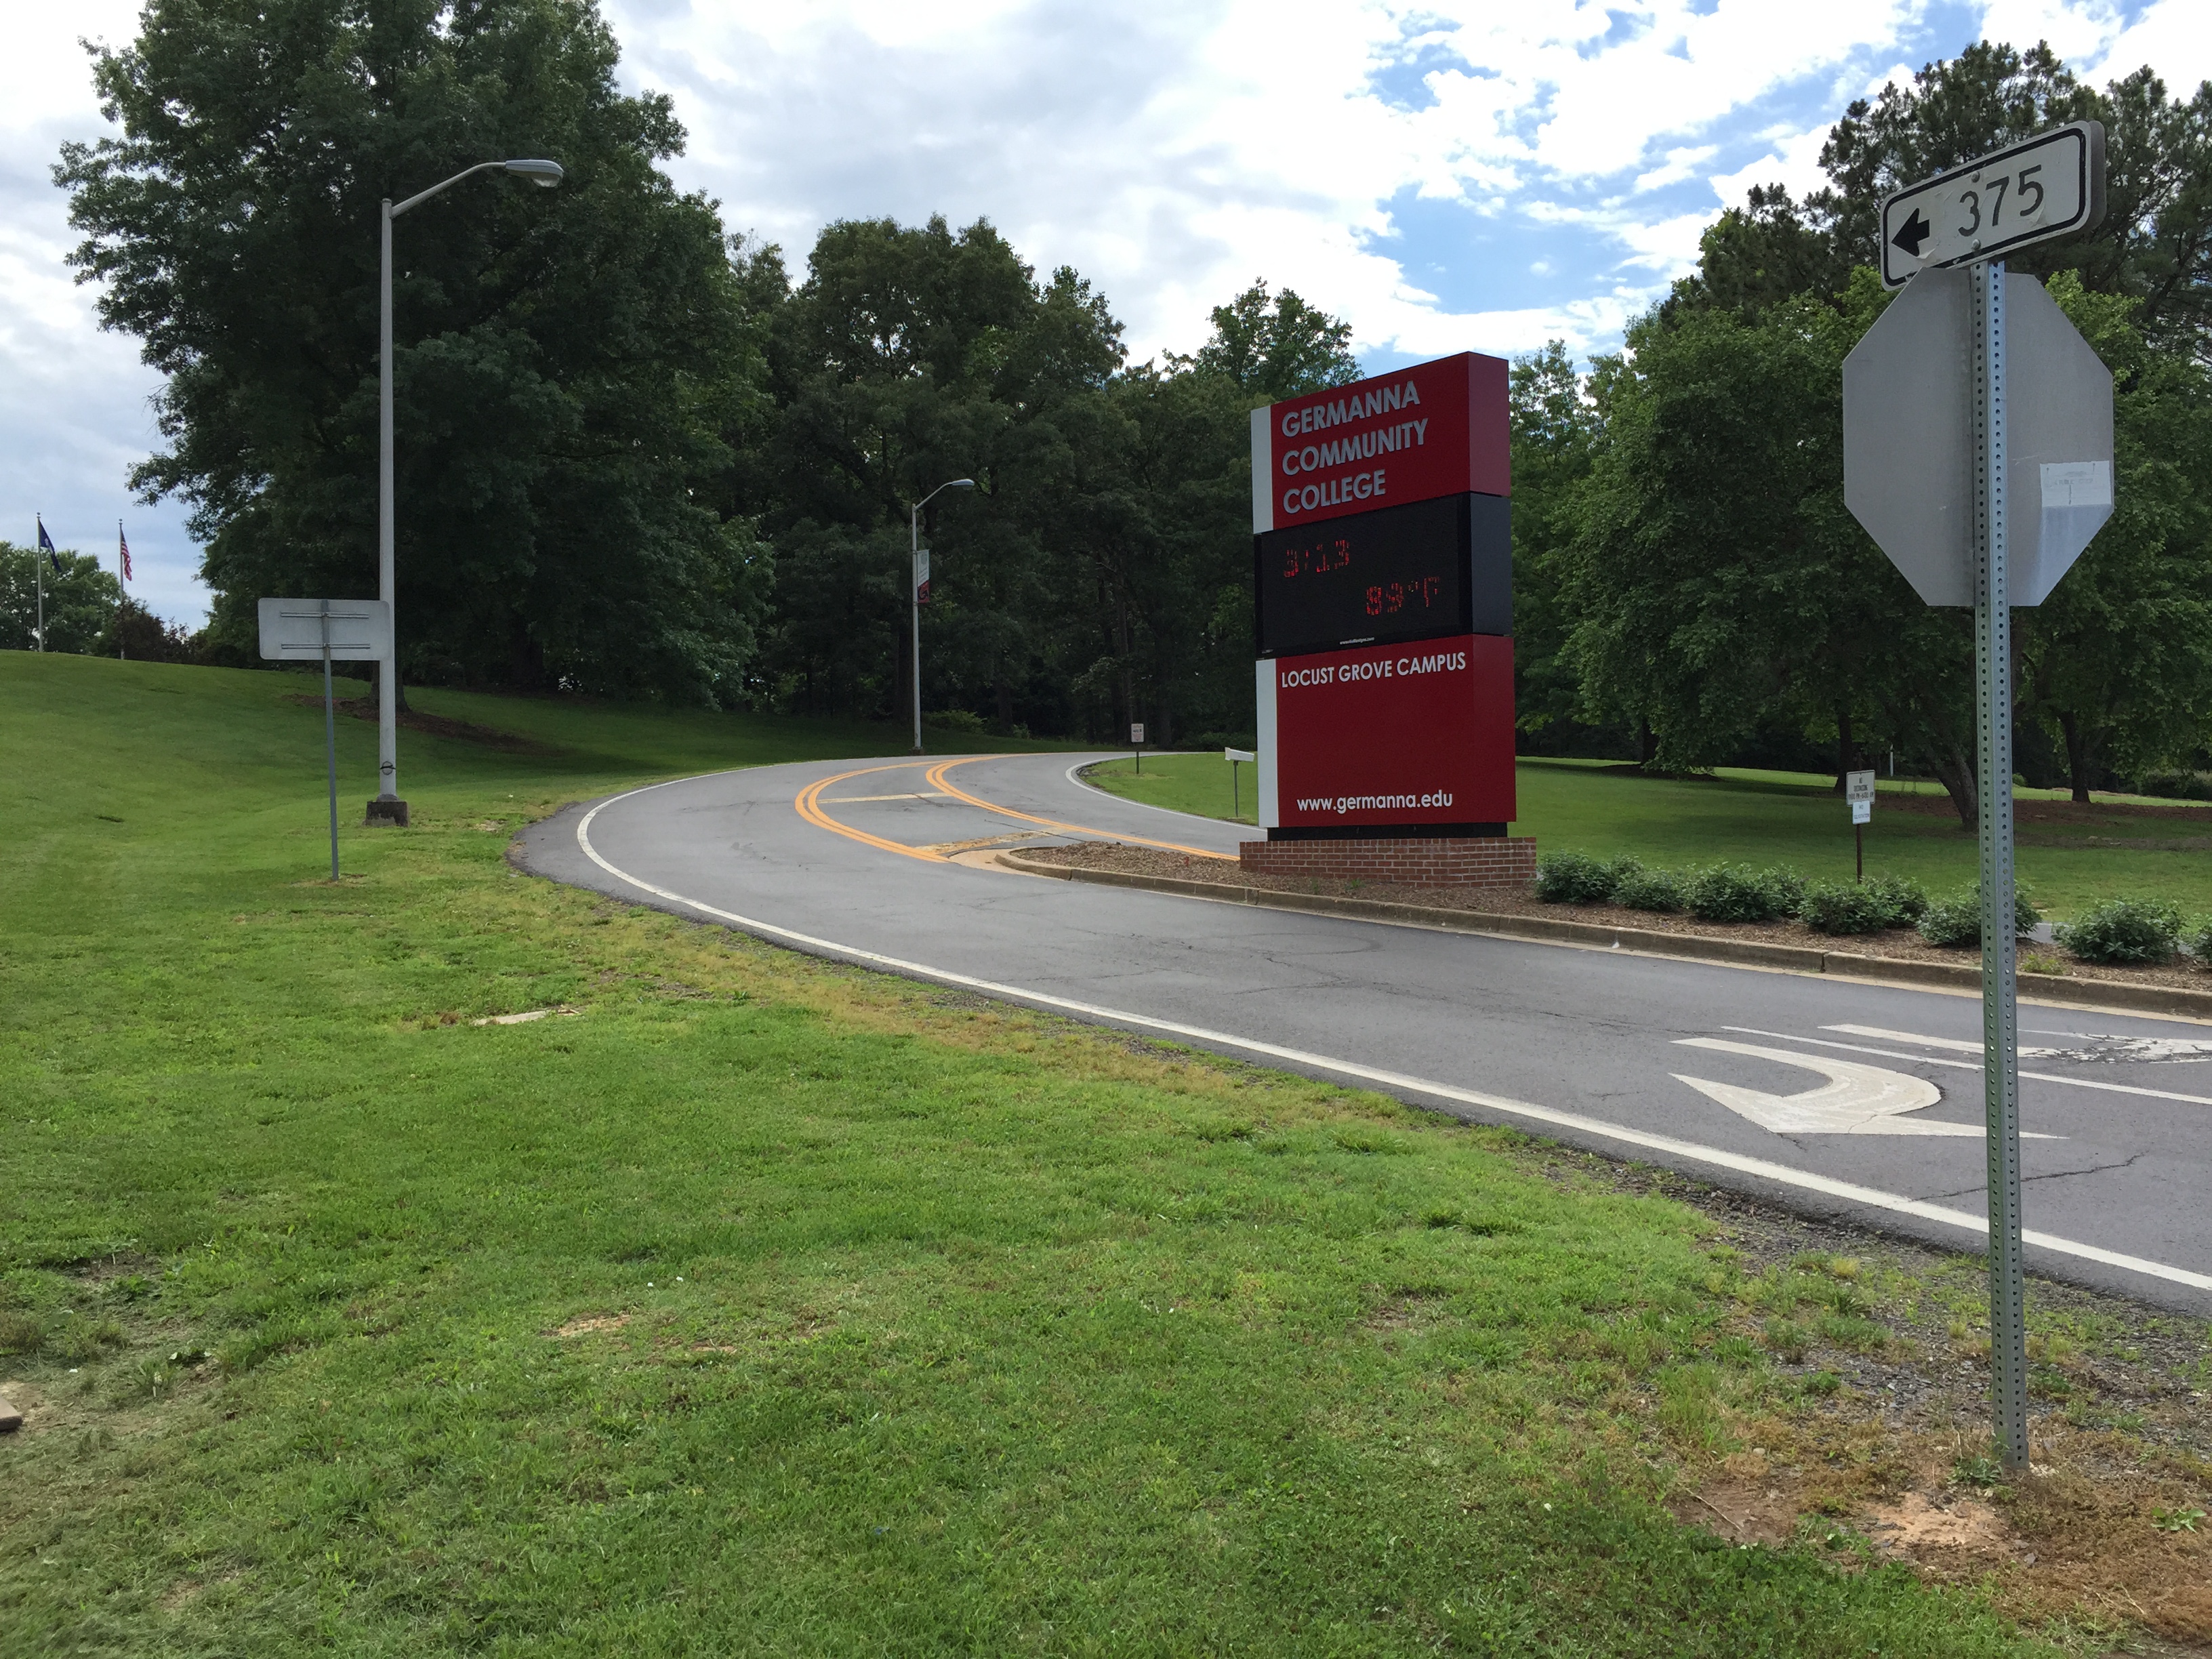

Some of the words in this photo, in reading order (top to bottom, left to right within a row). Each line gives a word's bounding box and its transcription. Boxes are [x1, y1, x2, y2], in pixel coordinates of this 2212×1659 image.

[1958, 165, 2044, 237] 375
[1282, 380, 1420, 438] GERMANNA
[1282, 417, 1429, 476] COMMUNITY
[1283, 469, 1386, 514] COLLEGE
[1282, 667, 1334, 689] LOCUST
[1338, 660, 1392, 682] GROVE
[1397, 651, 1466, 676] CAMPUS
[1296, 789, 1453, 814] www.germanna.edu
